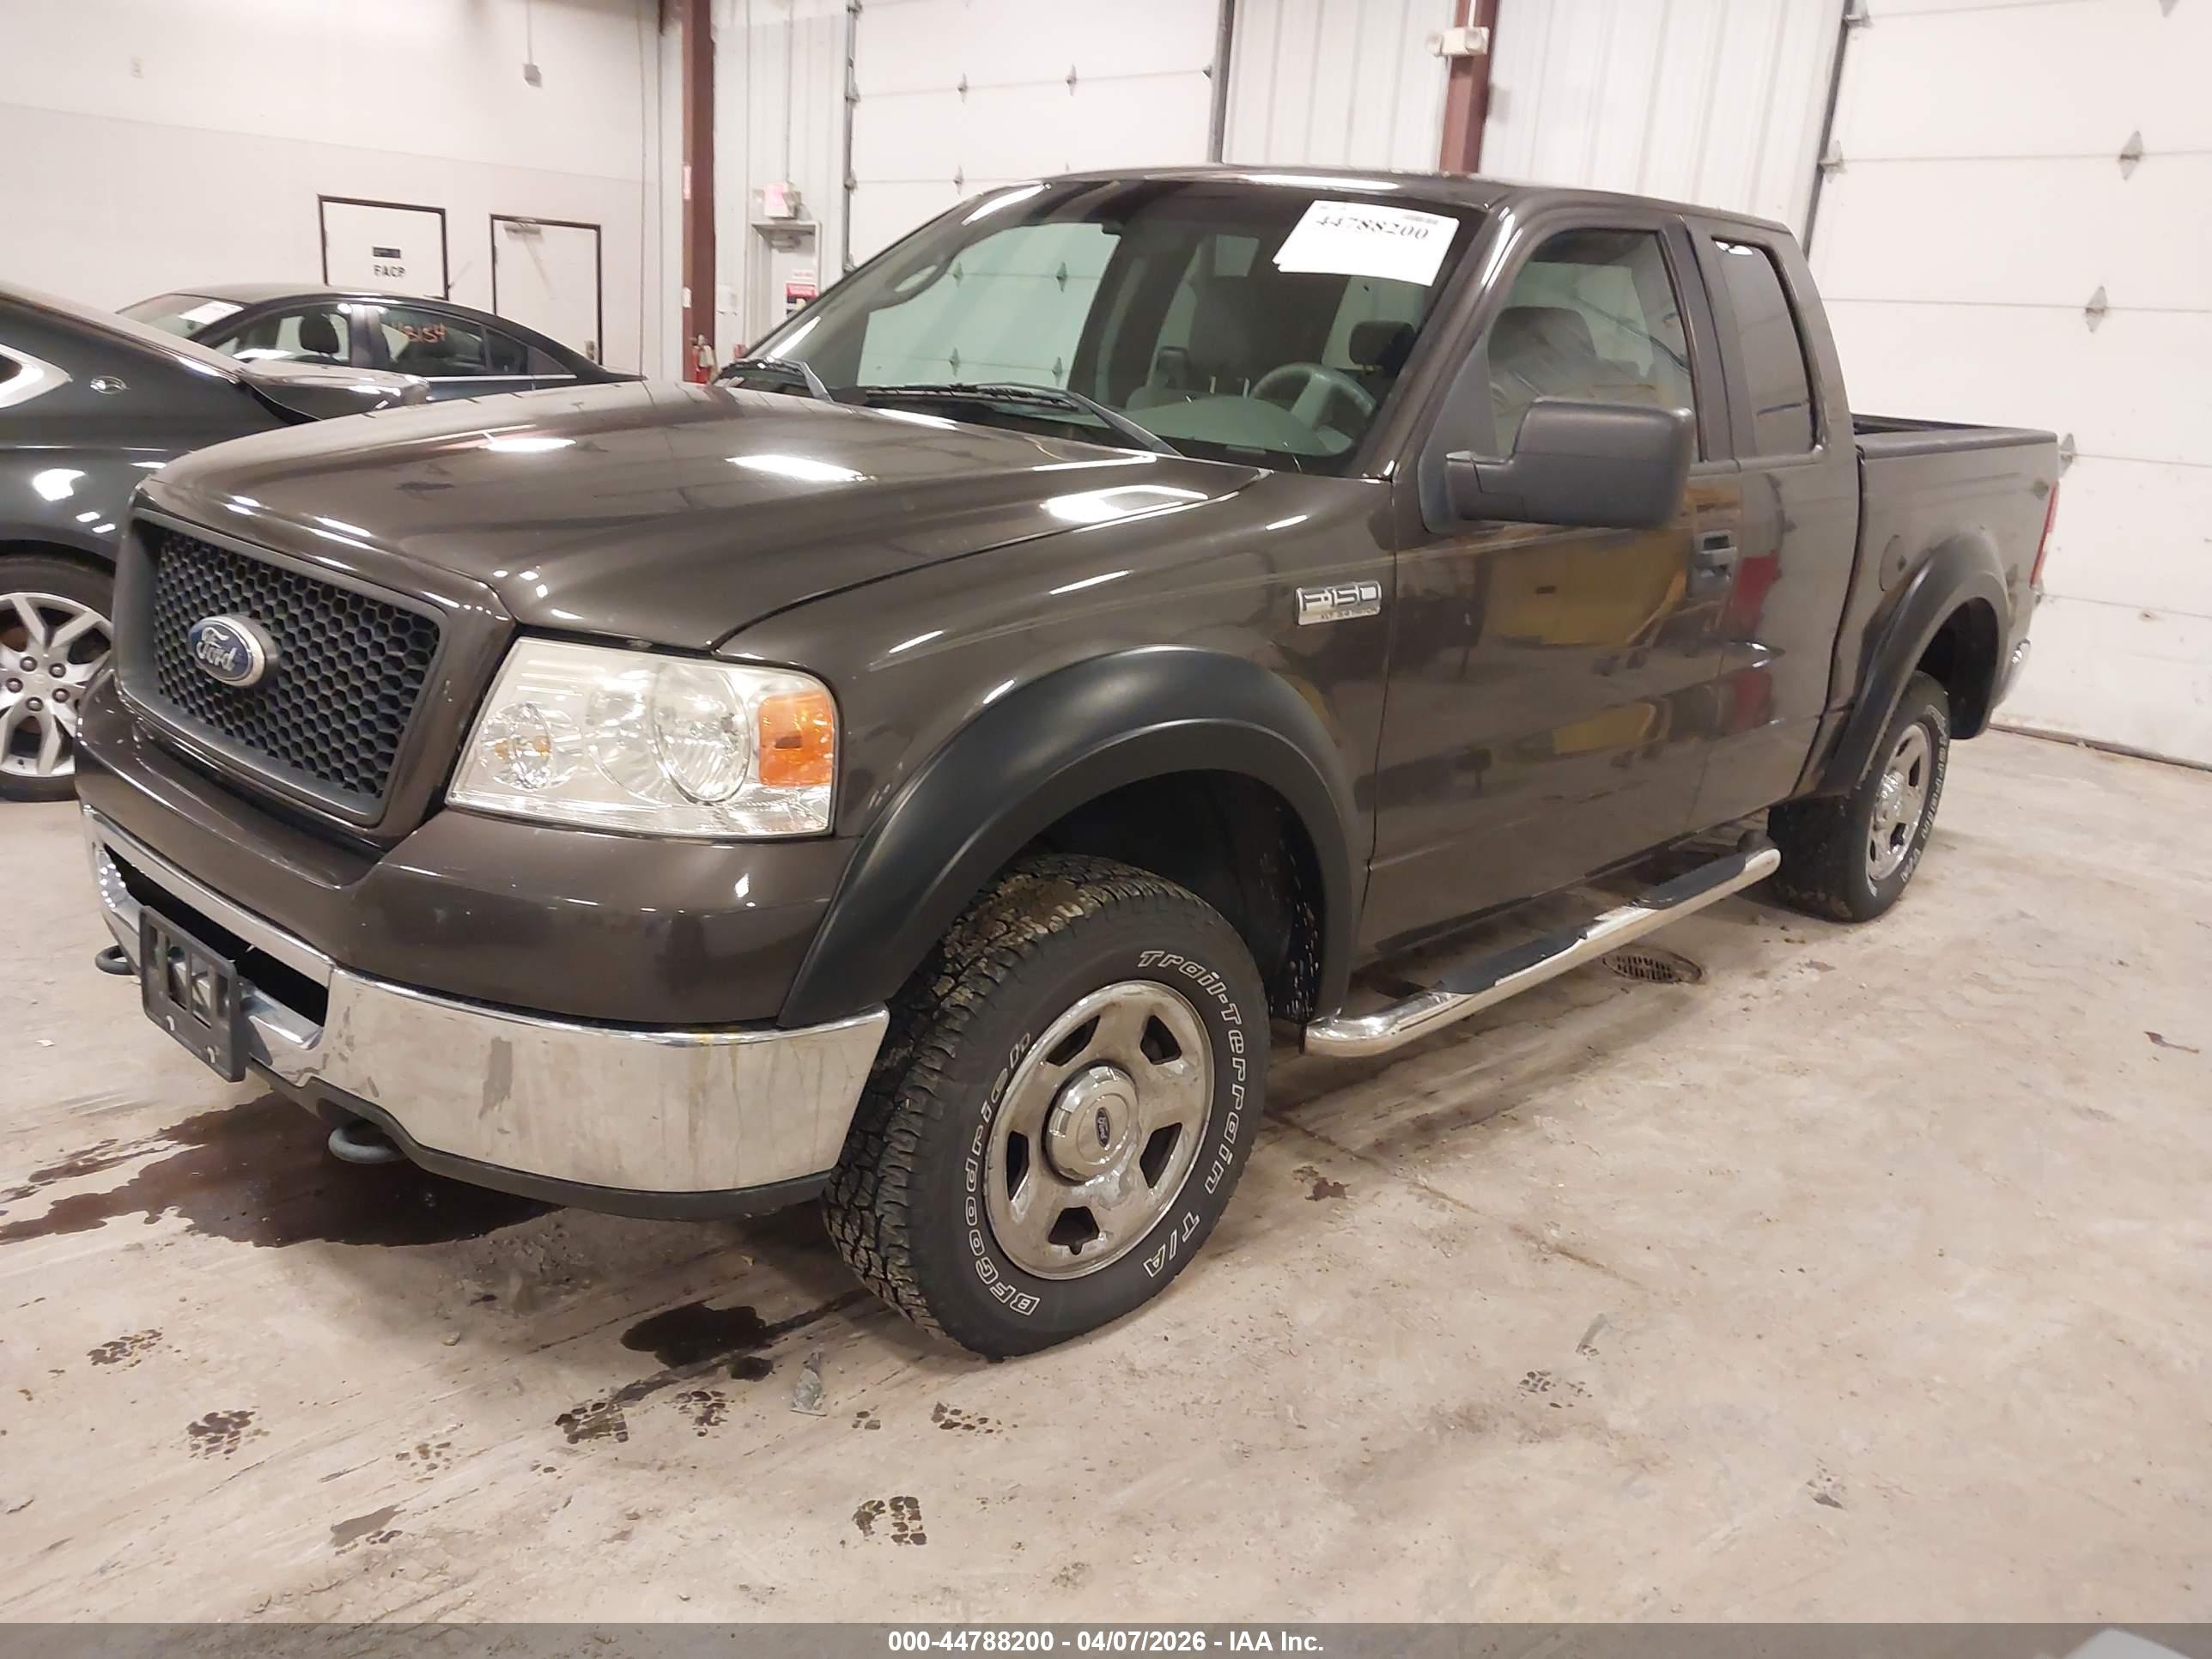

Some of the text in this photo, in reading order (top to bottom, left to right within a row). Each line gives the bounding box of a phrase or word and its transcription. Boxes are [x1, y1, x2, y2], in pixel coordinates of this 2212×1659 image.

[196, 626, 238, 672] Ford
[964, 1032, 1041, 1316] BFGoodrich
[1138, 951, 1247, 1279] Trail-Terrain T/A
